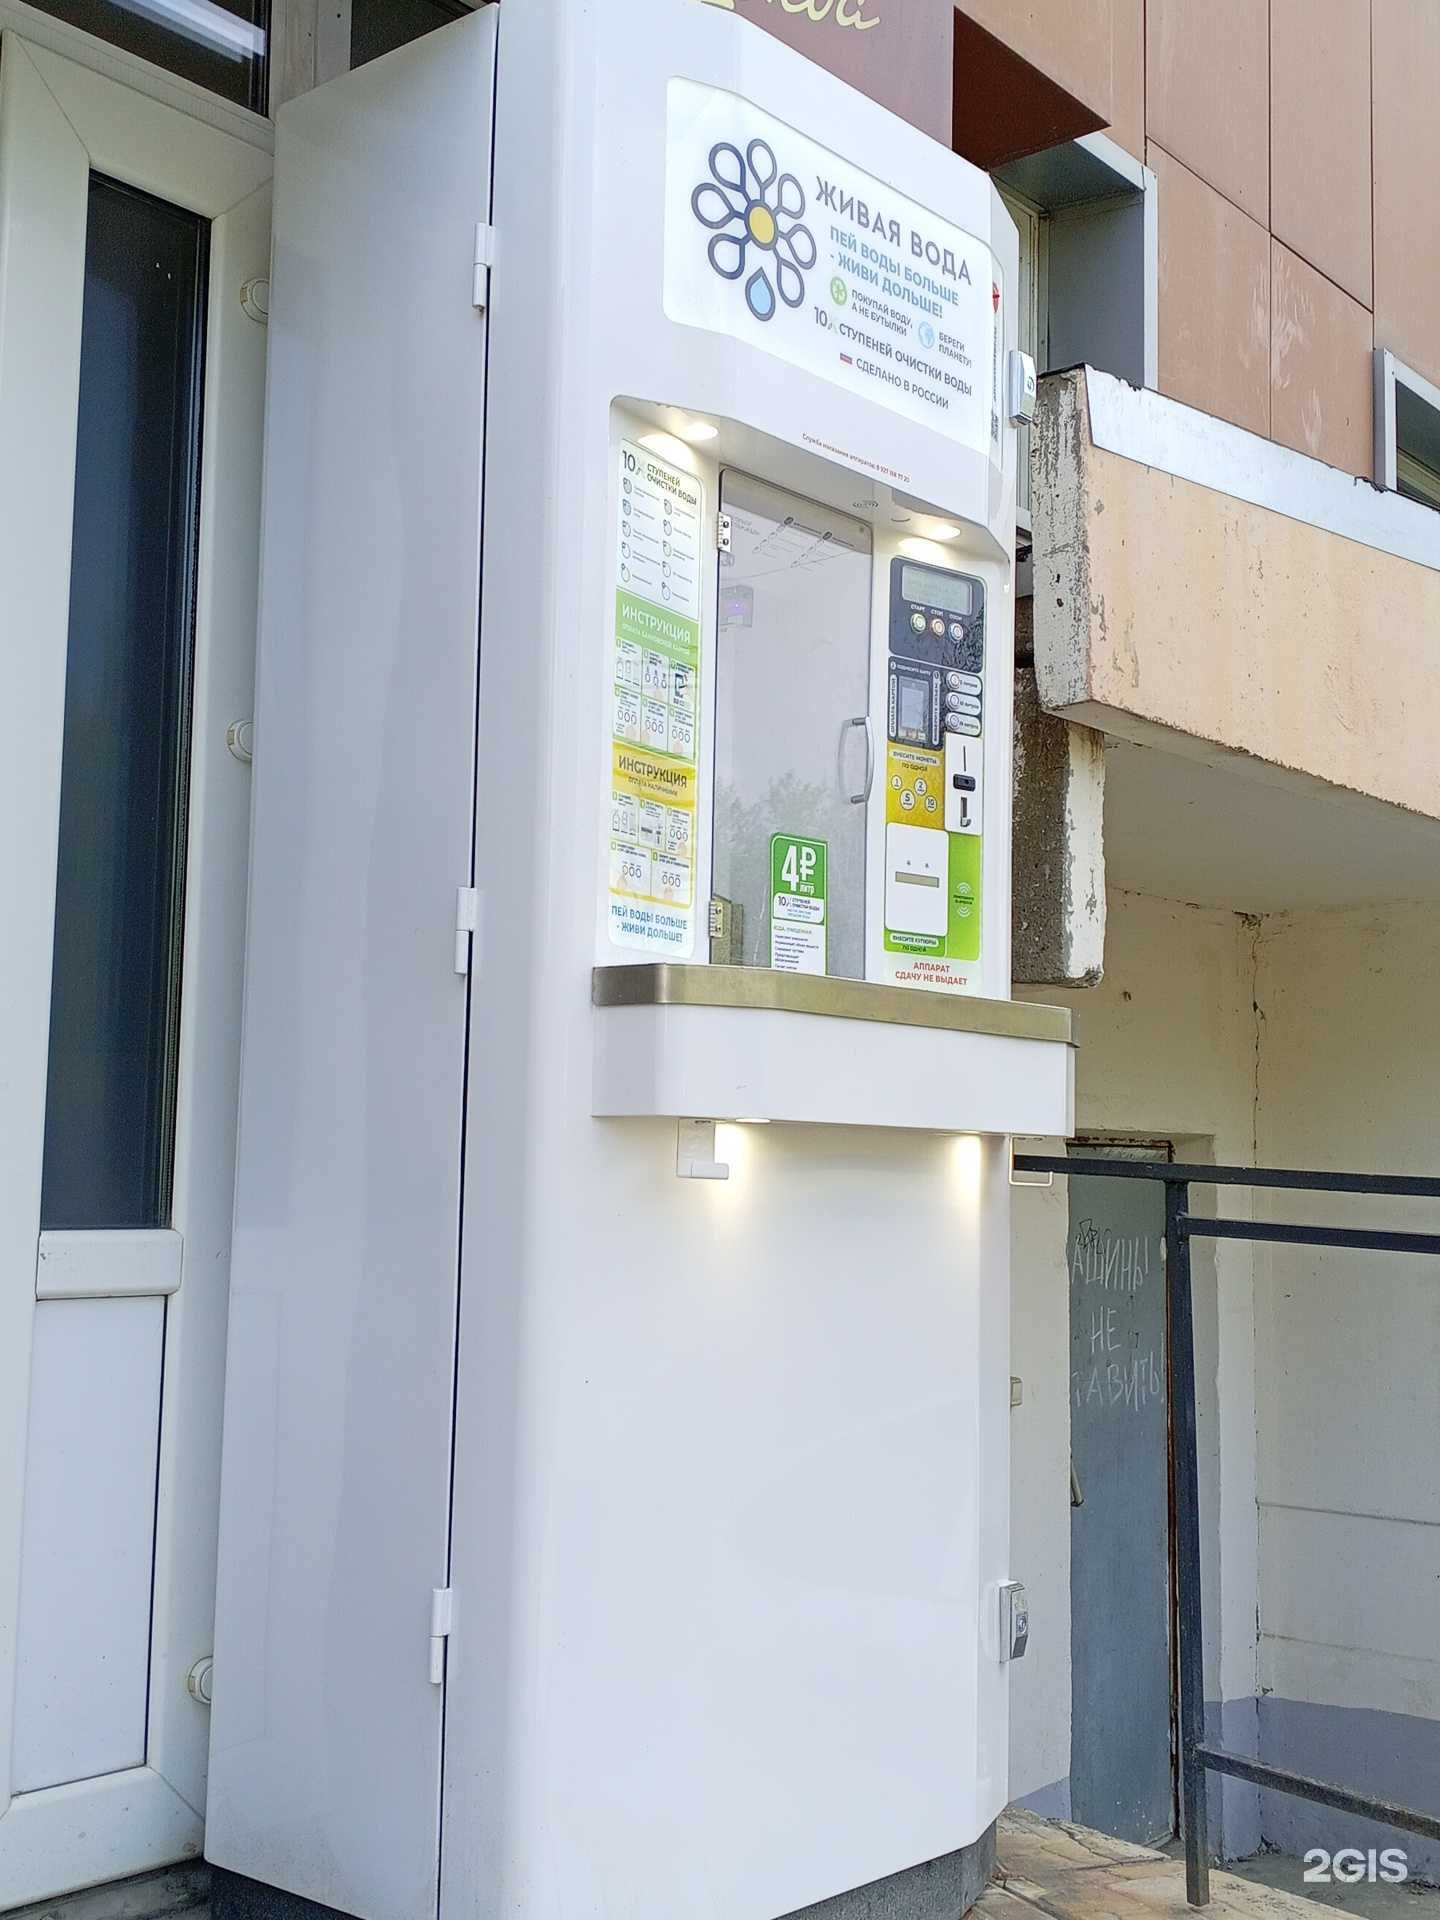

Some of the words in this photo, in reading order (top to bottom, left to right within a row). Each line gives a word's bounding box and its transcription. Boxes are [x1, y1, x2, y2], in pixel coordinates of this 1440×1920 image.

[816, 176, 901, 247] ЖИВАЯ
[911, 230, 972, 286] ВОДА
[830, 225, 858, 253] ПЕЙ
[860, 242, 901, 277] ВОДЫ
[904, 266, 960, 306] БОЛЬШЕ
[838, 252, 879, 287] ЖИВИ
[881, 277, 944, 319] ДОЛЬШЕ!
[851, 289, 889, 316] ПОКУПАЙ
[890, 309, 913, 329] ВОДУ,
[851, 302, 859, 312] А
[860, 306, 870, 318] НЕ
[870, 311, 907, 337] БУТЫЛКИ
[814, 306, 828, 328] 10
[839, 323, 893, 358] СТУПЕНЕЙ
[895, 350, 942, 381] ОЧИСТКИ
[944, 372, 972, 397] ВОДЫ
[938, 331, 965, 352] БЕРЕГИ
[856, 358, 902, 388] СДЕЛАНО
[903, 380, 910, 391] В
[911, 384, 949, 409] РОССИИ
[622, 449, 636, 472] 10
[647, 463, 681, 488] СТУПЕНЕЙ
[646, 473, 678, 496] ОЧИСТКИ
[678, 489, 697, 506] ВОДЫ
[622, 603, 690, 643] ИНСТРУКЦИЯ
[618, 755, 687, 788] ИНСТРУКЦИЯ
[893, 750, 915, 761] ВНЕСИТЕ
[916, 756, 937, 764] МОНЕТЫ
[904, 793, 910, 802] 5
[917, 781, 923, 789] 2
[927, 798, 934, 806] 10
[611, 905, 628, 917] ПЕЙ
[630, 910, 653, 922] ВОДЫ
[655, 914, 688, 930] БОЛЬШЕ
[778, 896, 787, 907] 10
[621, 921, 646, 935] ЖИВИ
[647, 926, 683, 943] ДОЛЬШЕ!
[895, 971, 922, 982] СДАЧУ
[923, 974, 934, 983] НЕ
[935, 975, 967, 985] ВЫДАЕТ
[913, 961, 950, 973] АППАРАТ
[1090, 1305, 1121, 1354] НЕ
